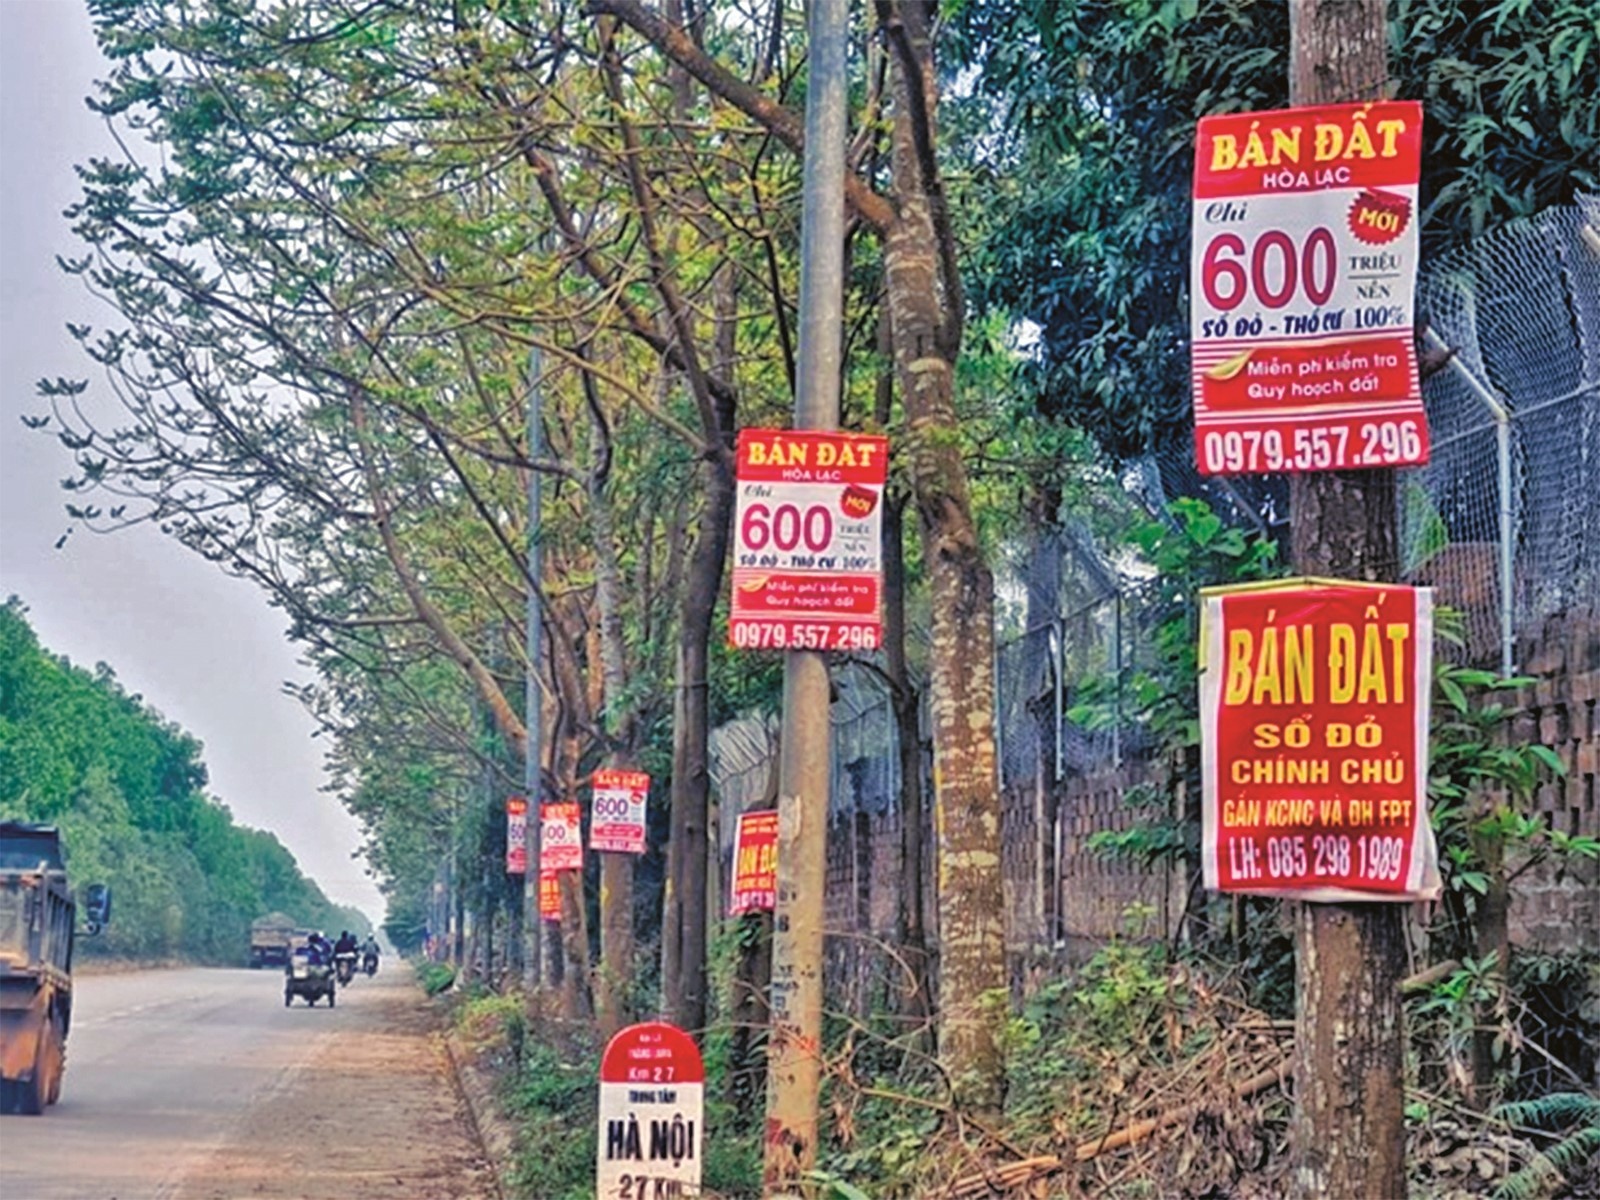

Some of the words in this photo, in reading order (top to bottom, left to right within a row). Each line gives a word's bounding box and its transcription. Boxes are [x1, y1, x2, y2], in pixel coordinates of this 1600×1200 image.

[1210, 121, 1302, 171] BÁN
[1314, 103, 1406, 161] ĐẤT
[1263, 168, 1309, 189] HÒA
[1315, 167, 1350, 190] LẠC
[1202, 227, 1337, 311] 600
[1354, 306, 1406, 329] 100%
[1374, 353, 1398, 368] tra
[1247, 384, 1285, 400] Quy
[1349, 373, 1379, 392] đất
[748, 436, 809, 466] BÁN
[1204, 421, 1422, 472] 0979.557.296
[741, 503, 832, 553] 600
[734, 623, 876, 649] 0979.557.296
[1225, 609, 1313, 706] BÁN
[1328, 592, 1410, 704] ĐẤT
[1253, 713, 1311, 748] SỔ
[1325, 714, 1382, 748] ĐỎ
[1231, 754, 1330, 784] CHÍNH
[1341, 752, 1404, 784] CHỦ
[595, 797, 628, 815] 600
[1265, 799, 1314, 827] KCNC
[1319, 793, 1343, 827] VÀ
[1348, 799, 1373, 827] ĐH
[1379, 799, 1411, 828] FPT
[1229, 837, 1262, 880] LH:
[1268, 836, 1308, 878] 085
[1313, 835, 1351, 877] 298
[1357, 836, 1404, 881] 1989
[607, 1112, 643, 1161] HÀ
[650, 1113, 694, 1168] NỘI
[619, 1174, 648, 1200] 27
